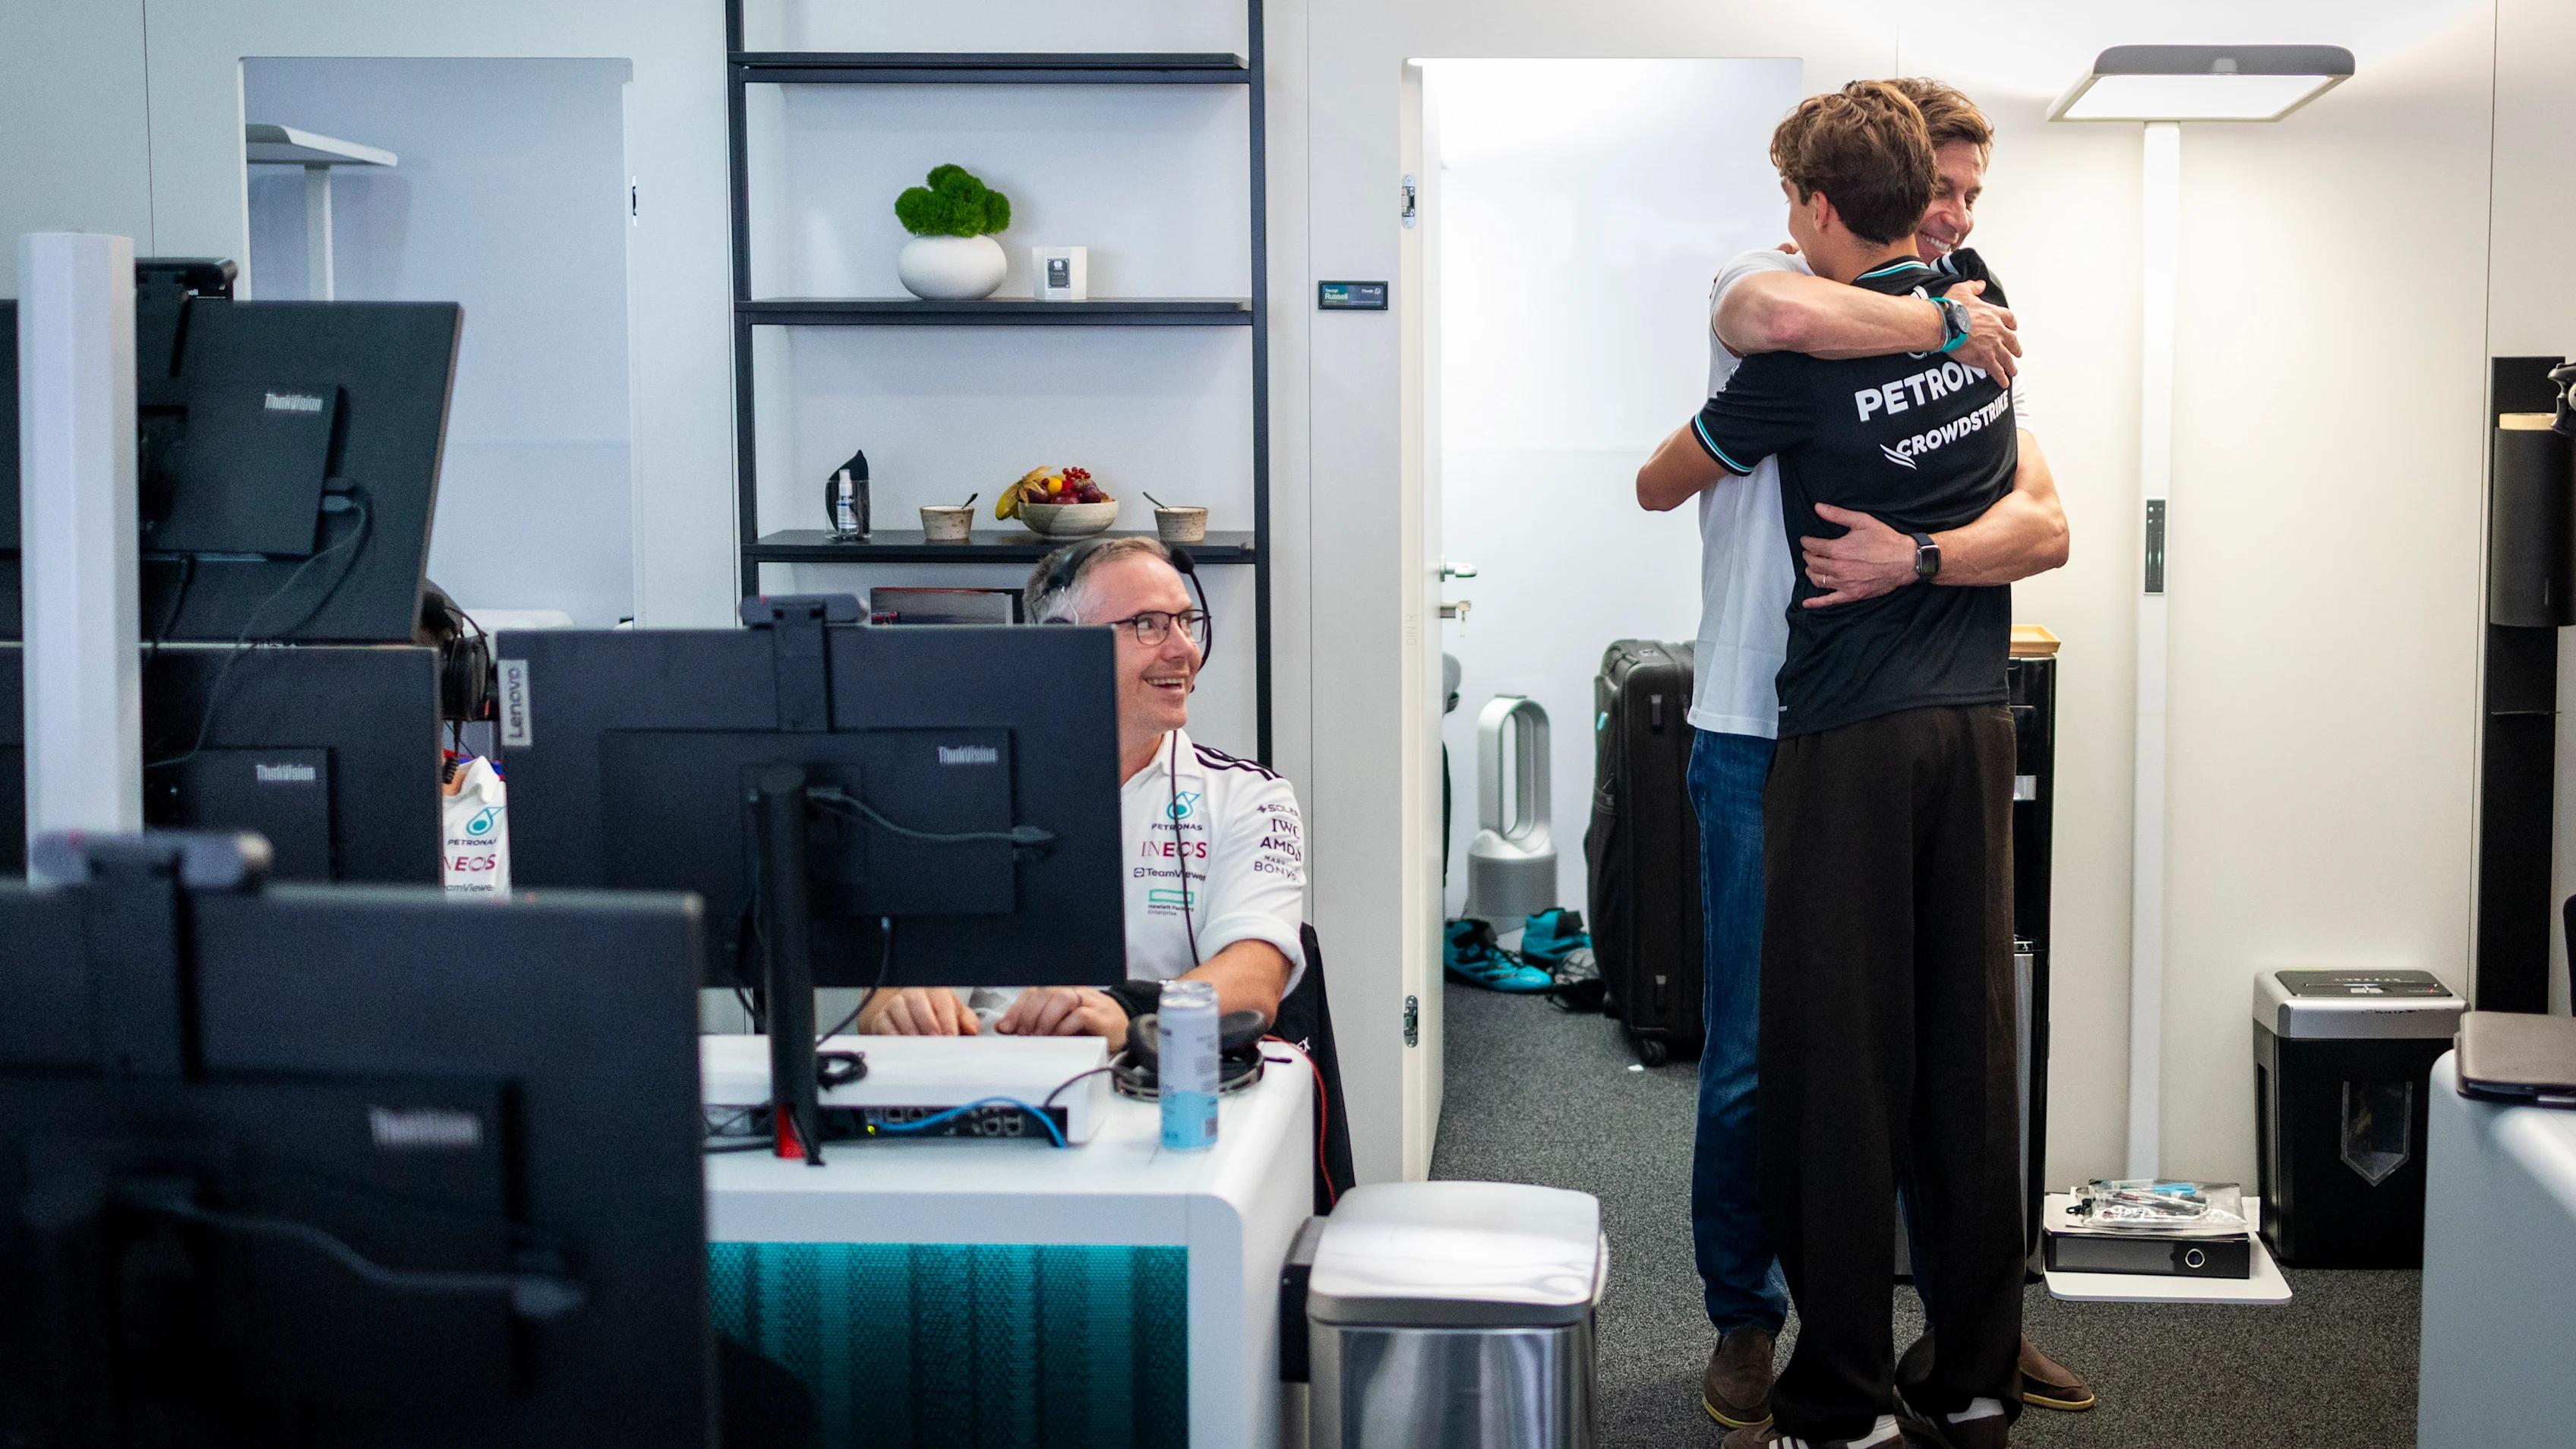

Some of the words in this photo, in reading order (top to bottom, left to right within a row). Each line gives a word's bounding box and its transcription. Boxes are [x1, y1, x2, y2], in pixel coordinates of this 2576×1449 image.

[1854, 361, 1989, 422] PETRON
[264, 393, 323, 412] ThinkVision
[1896, 390, 2009, 457] CROWDSTRIKE
[508, 668, 524, 738] Lenovo
[938, 745, 998, 763] ThinkVision
[1272, 818, 1300, 839] IWC
[1141, 841, 1208, 858] INEOS
[444, 854, 497, 872] NEOS
[1146, 868, 1206, 882] TeamVewer
[446, 883, 494, 892] amViewe
